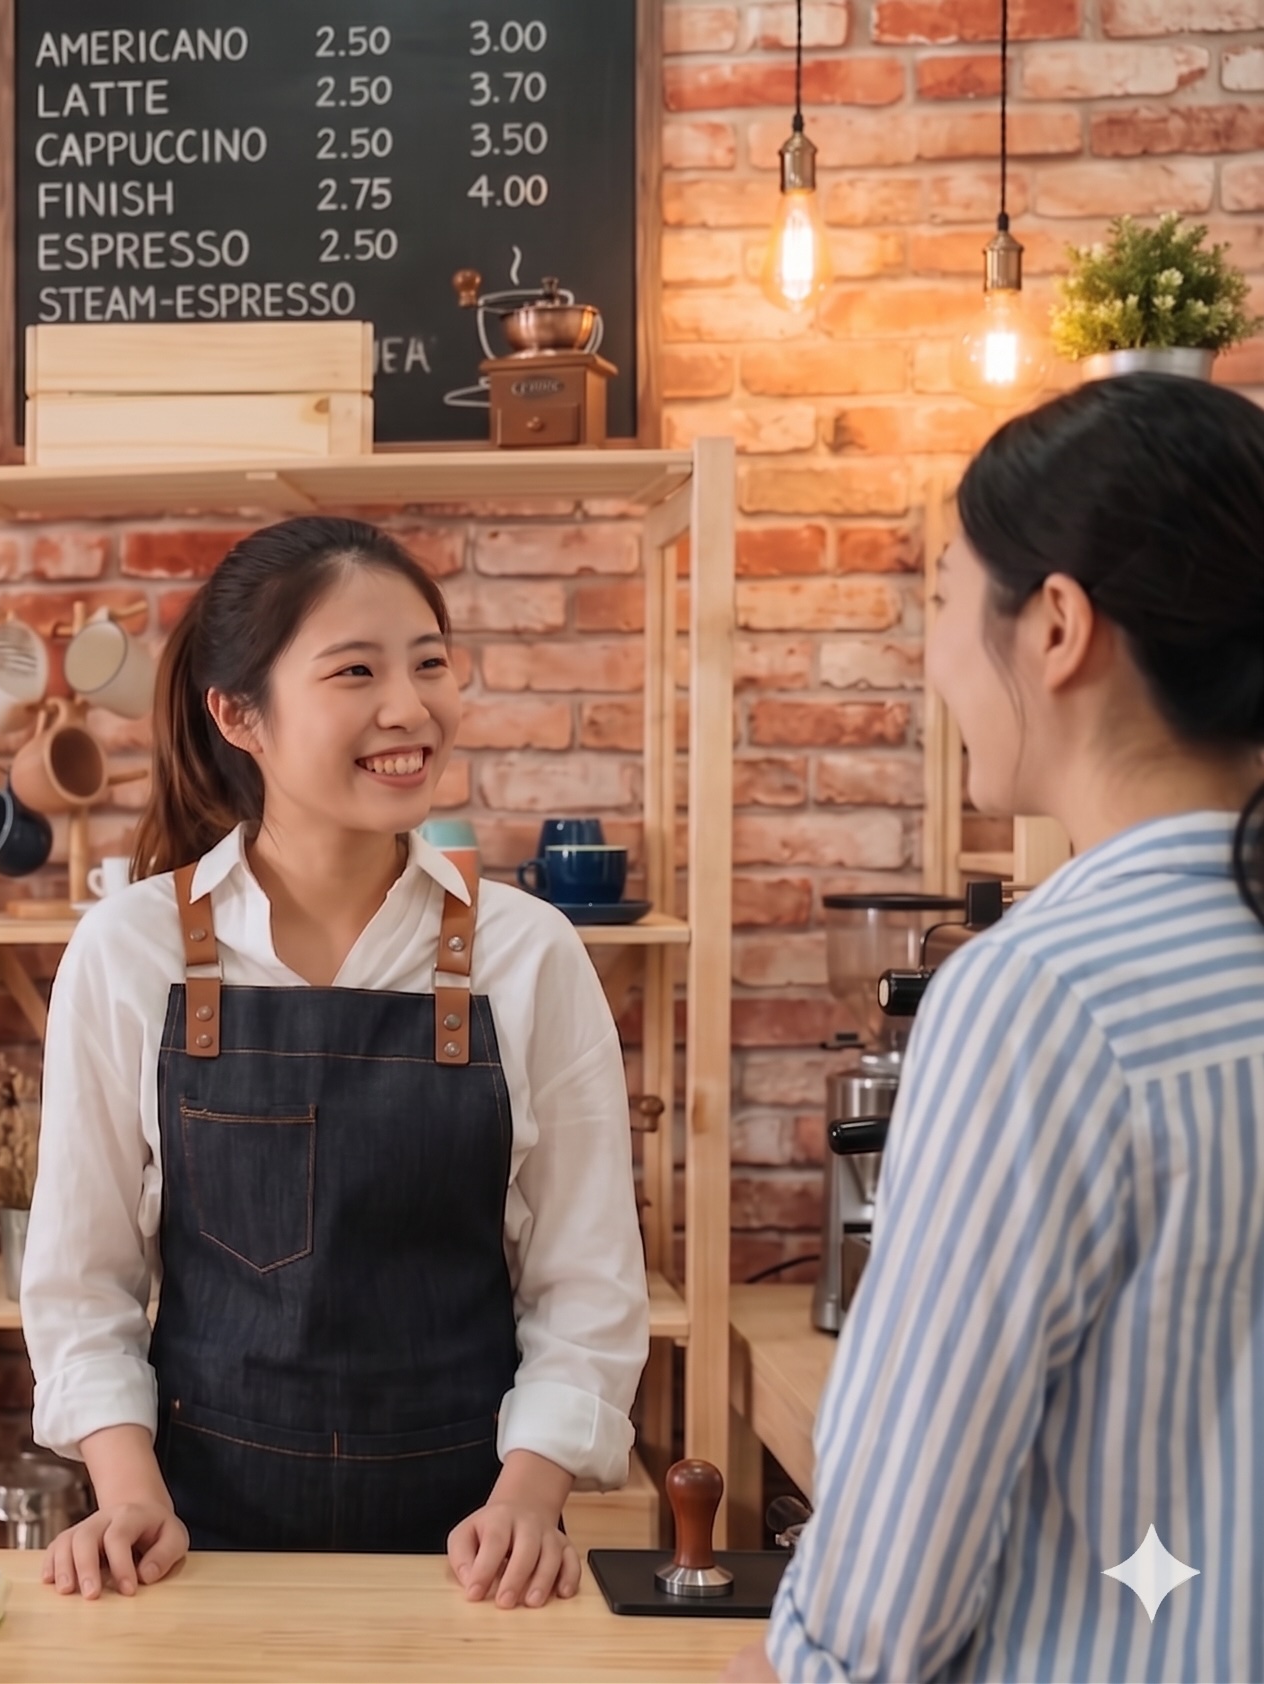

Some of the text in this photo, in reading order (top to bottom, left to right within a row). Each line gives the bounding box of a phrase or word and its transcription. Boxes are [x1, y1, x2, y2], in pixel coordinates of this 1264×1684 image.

[35, 20, 548, 68] AMERICANO 2.50 3.00
[36, 71, 548, 118] LATTE 2.50 3.70
[35, 122, 549, 168] CAPPUCCINO 2.50 3.50
[37, 174, 549, 219] FINISH 2.75 4.00
[37, 228, 398, 271] ESPRESSO 2.50
[37, 282, 356, 321] STEAM-ESPRESSO
[375, 336, 431, 374] EA
